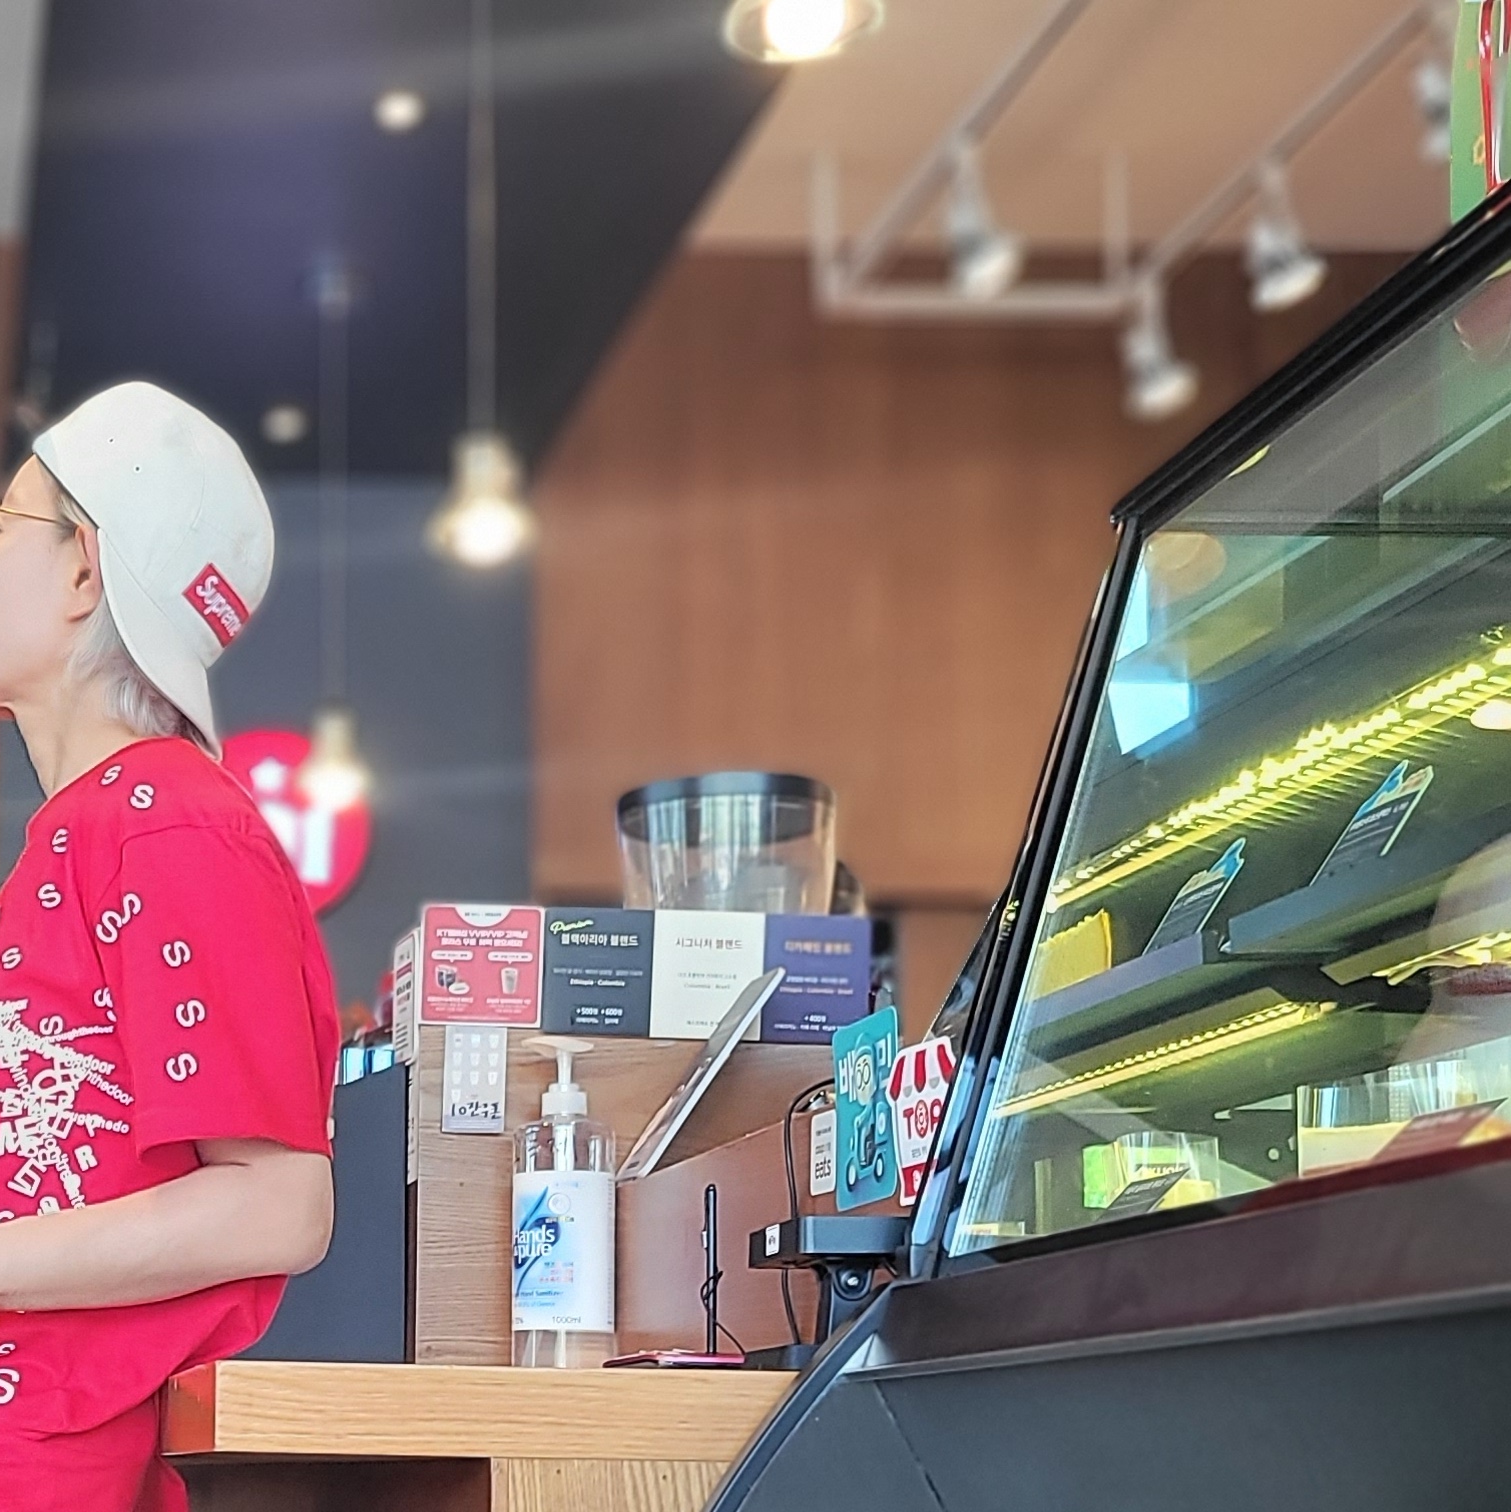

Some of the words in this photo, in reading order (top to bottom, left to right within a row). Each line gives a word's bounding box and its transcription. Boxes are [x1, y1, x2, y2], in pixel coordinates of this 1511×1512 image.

[129, 784, 155, 809] S
[37, 883, 62, 908] S
[162, 940, 192, 968] S
[176, 1000, 206, 1028] S
